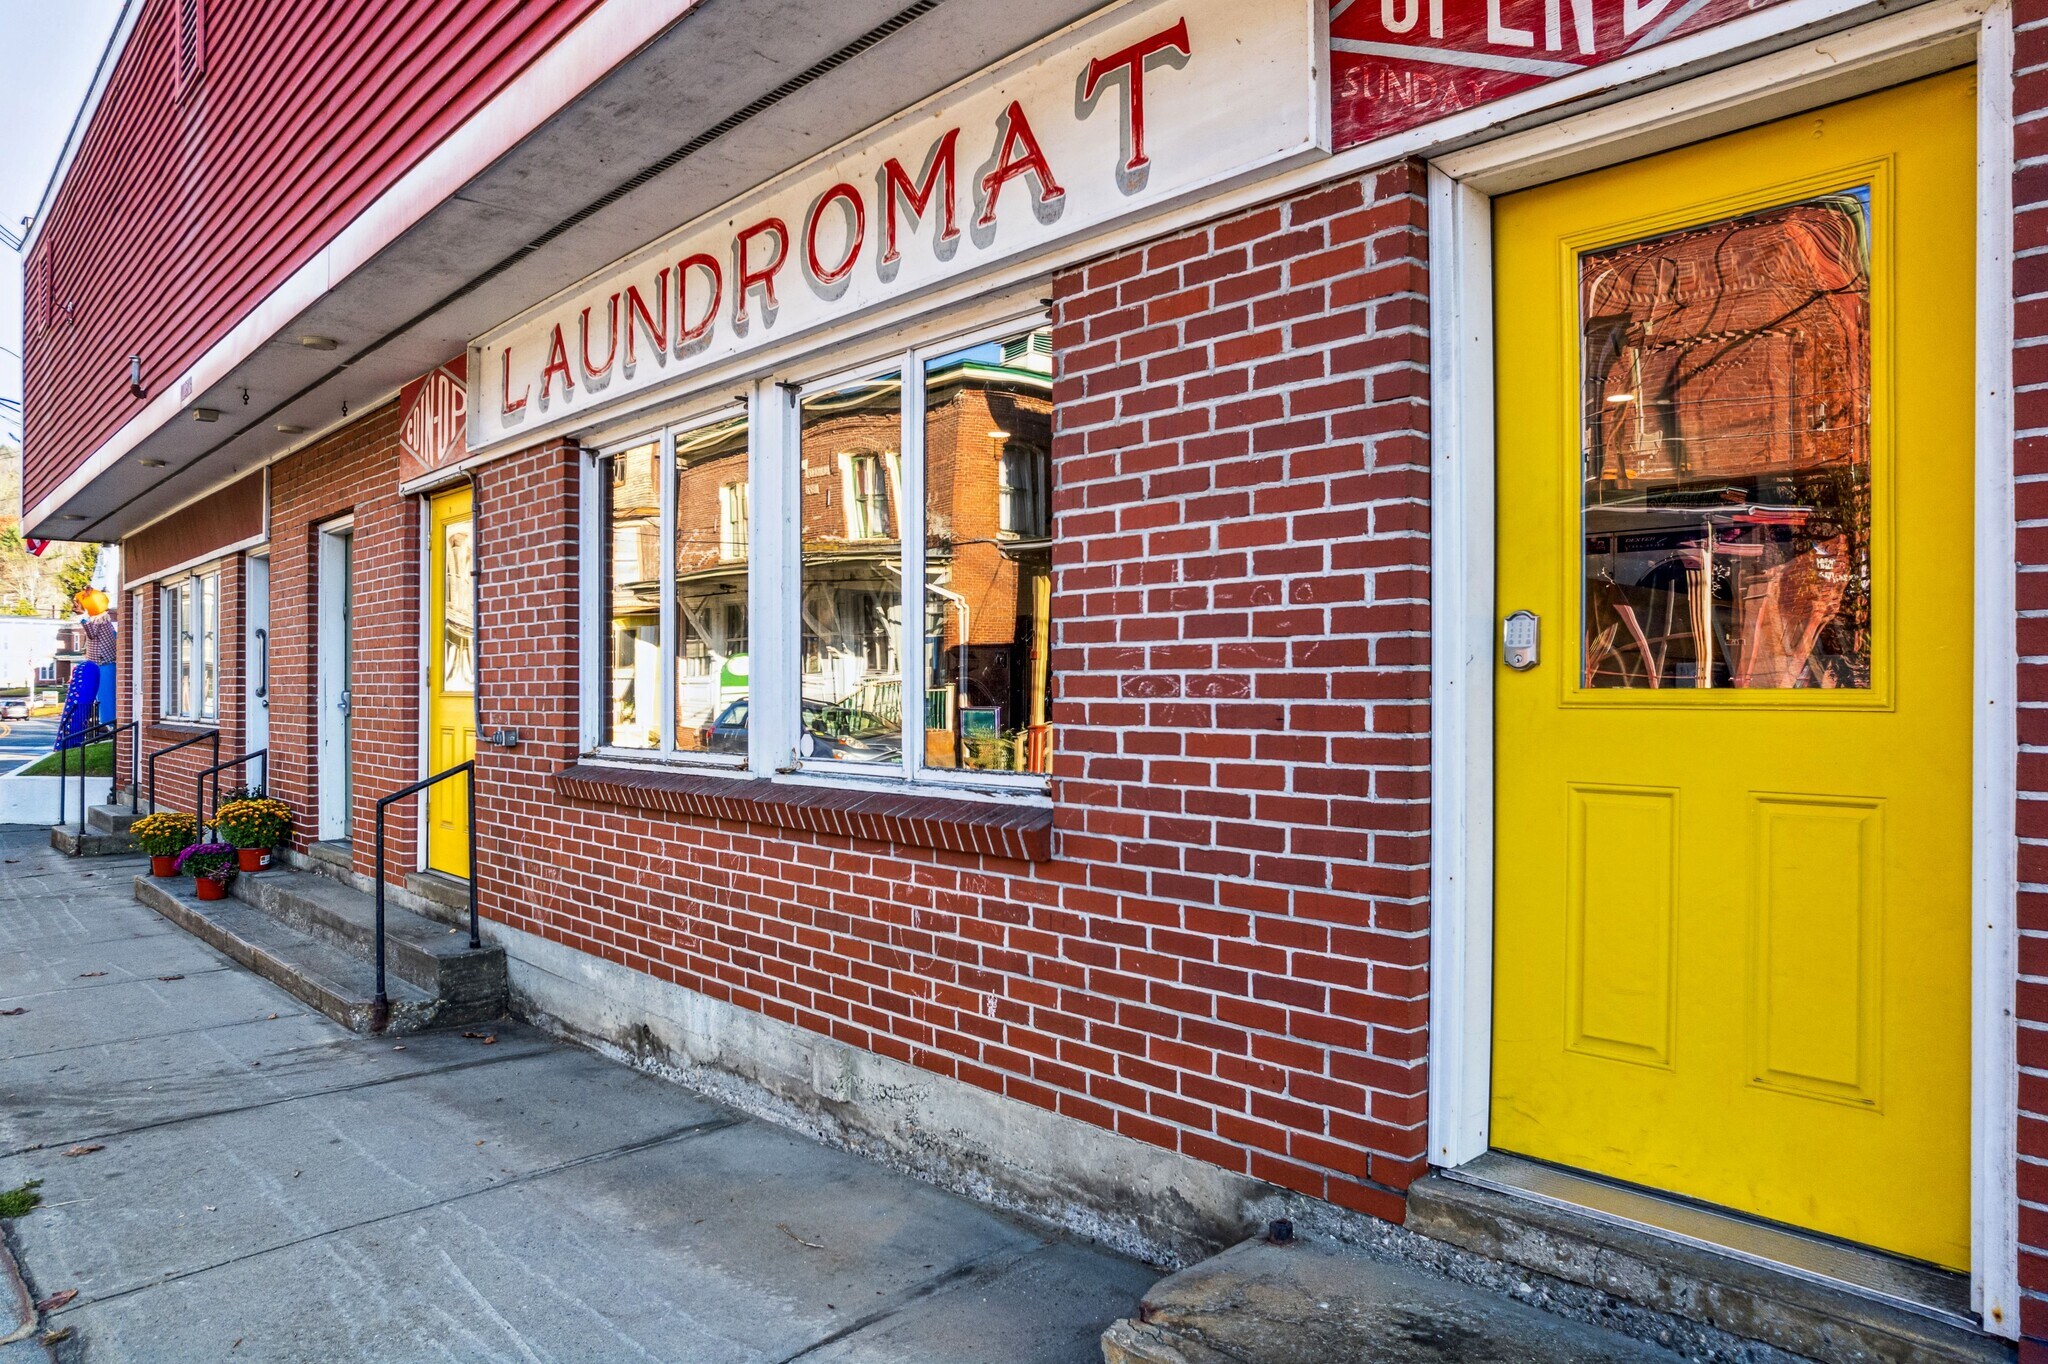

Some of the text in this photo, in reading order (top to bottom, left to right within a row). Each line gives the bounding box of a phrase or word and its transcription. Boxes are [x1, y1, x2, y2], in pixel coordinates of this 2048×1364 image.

[1341, 64, 1488, 111] SUNDAY
[502, 16, 1191, 418] LAUNDROMAT
[407, 375, 467, 467] COIN-OP
